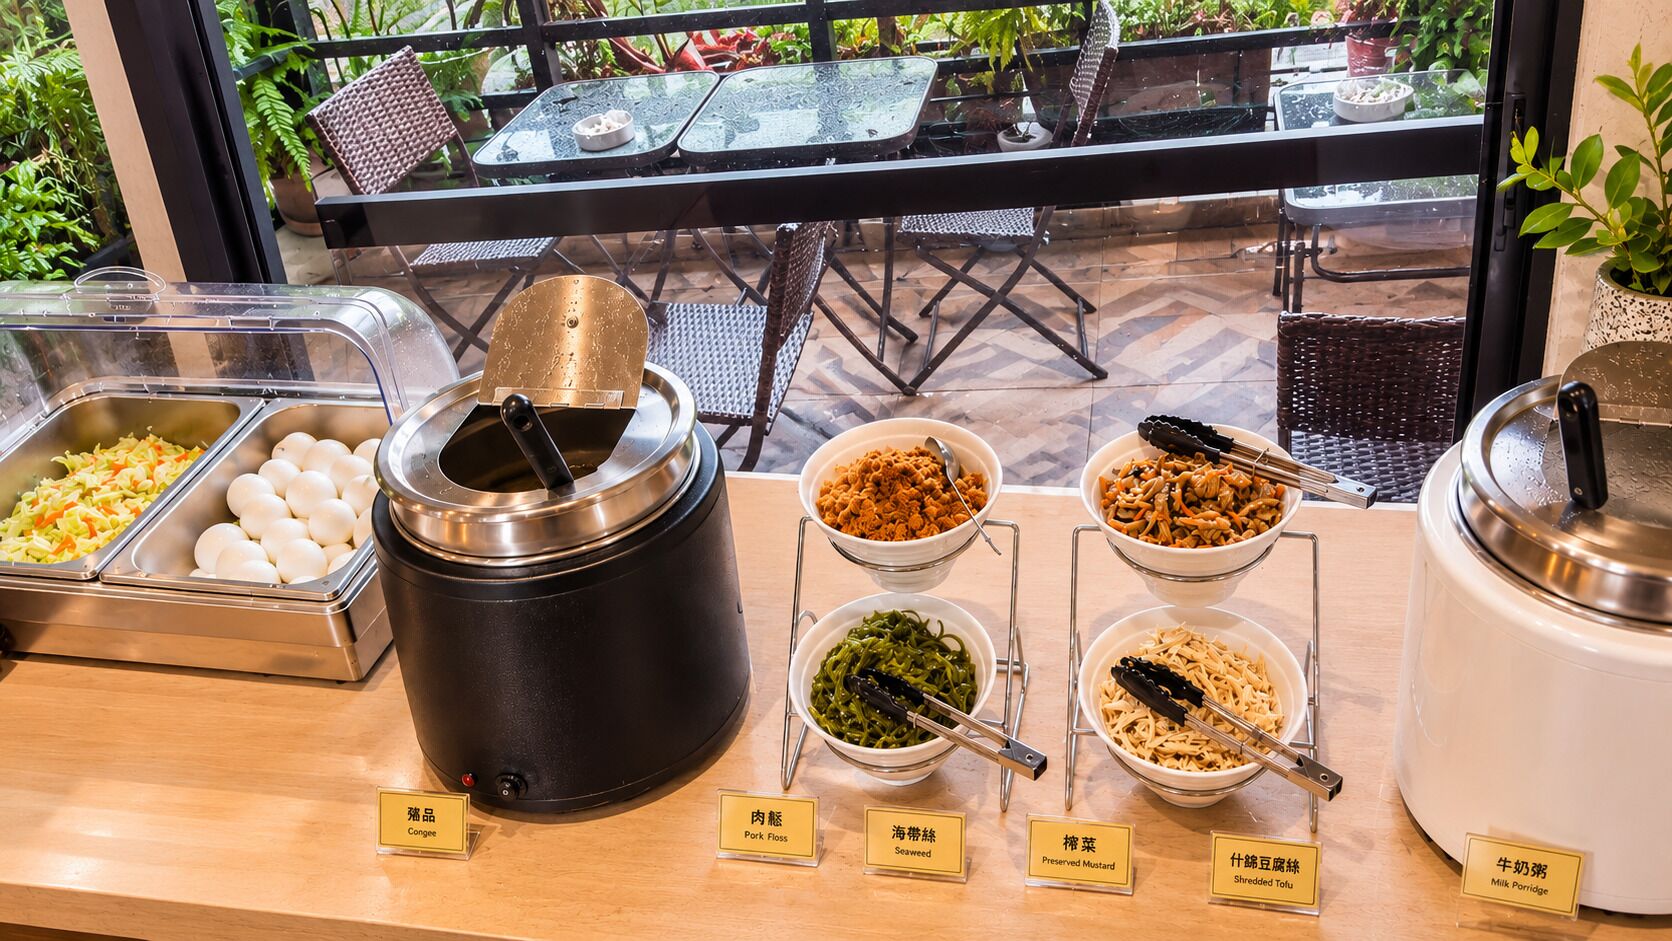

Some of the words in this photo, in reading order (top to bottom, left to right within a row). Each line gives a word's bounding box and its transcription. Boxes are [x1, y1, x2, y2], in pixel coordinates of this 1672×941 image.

[408, 827, 436, 838] Congee
[745, 831, 764, 840] Pork
[768, 833, 788, 842] Floss
[895, 847, 931, 858] Seaweed
[1043, 856, 1080, 867] Preserved
[1083, 860, 1115, 870] Mustard
[1496, 857, 1548, 879] 牛奶粥
[1234, 875, 1273, 886] Shredded
[1275, 880, 1293, 889] Tofu
[1491, 878, 1509, 888] Milk
[1512, 881, 1548, 896] Porridge
